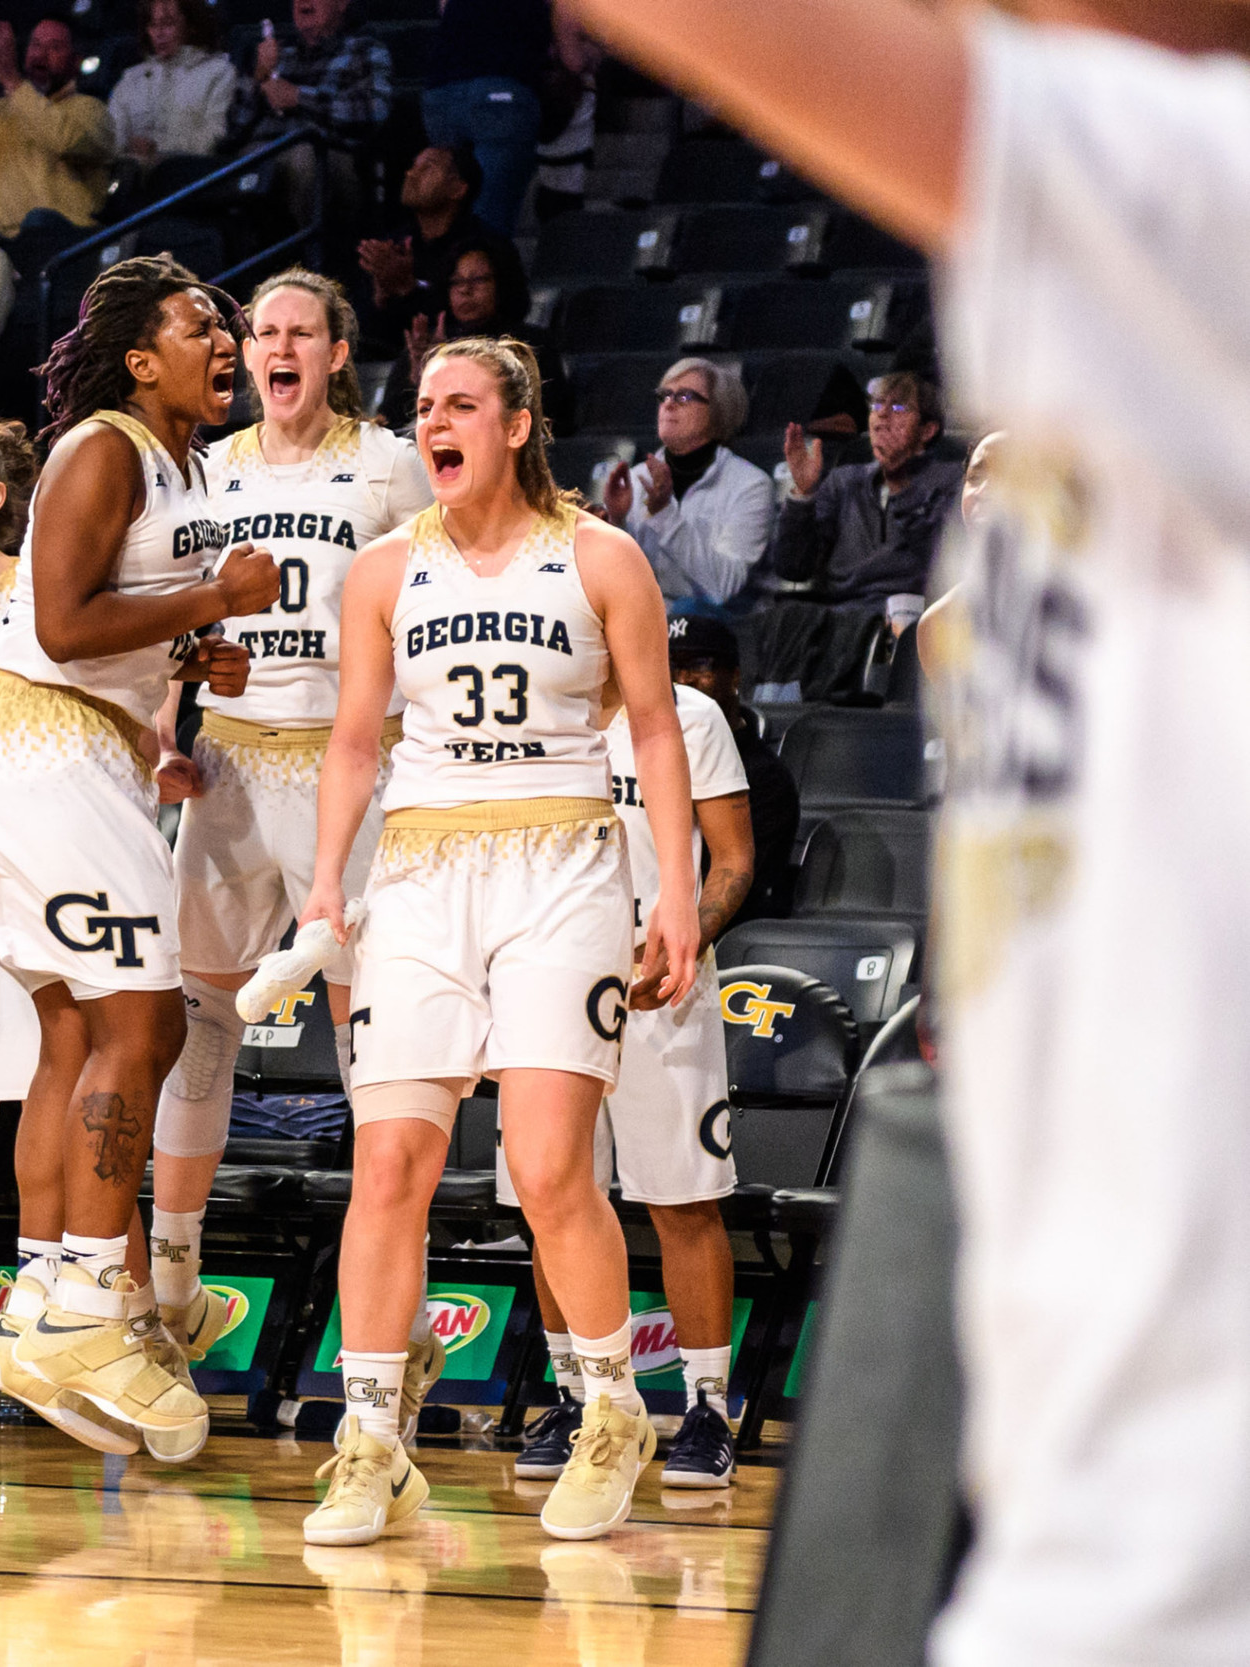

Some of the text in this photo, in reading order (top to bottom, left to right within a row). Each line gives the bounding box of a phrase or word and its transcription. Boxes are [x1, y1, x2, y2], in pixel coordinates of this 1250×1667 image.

[331, 474, 355, 483] ACC
[537, 562, 566, 573] ACC
[407, 611, 573, 660] GEORGIA
[446, 663, 528, 728] 33
[45, 891, 161, 968] GT
[720, 980, 796, 1039] GT
[150, 1236, 191, 1263] GT
[581, 1354, 629, 1382] GT
[346, 1376, 398, 1408] GT
